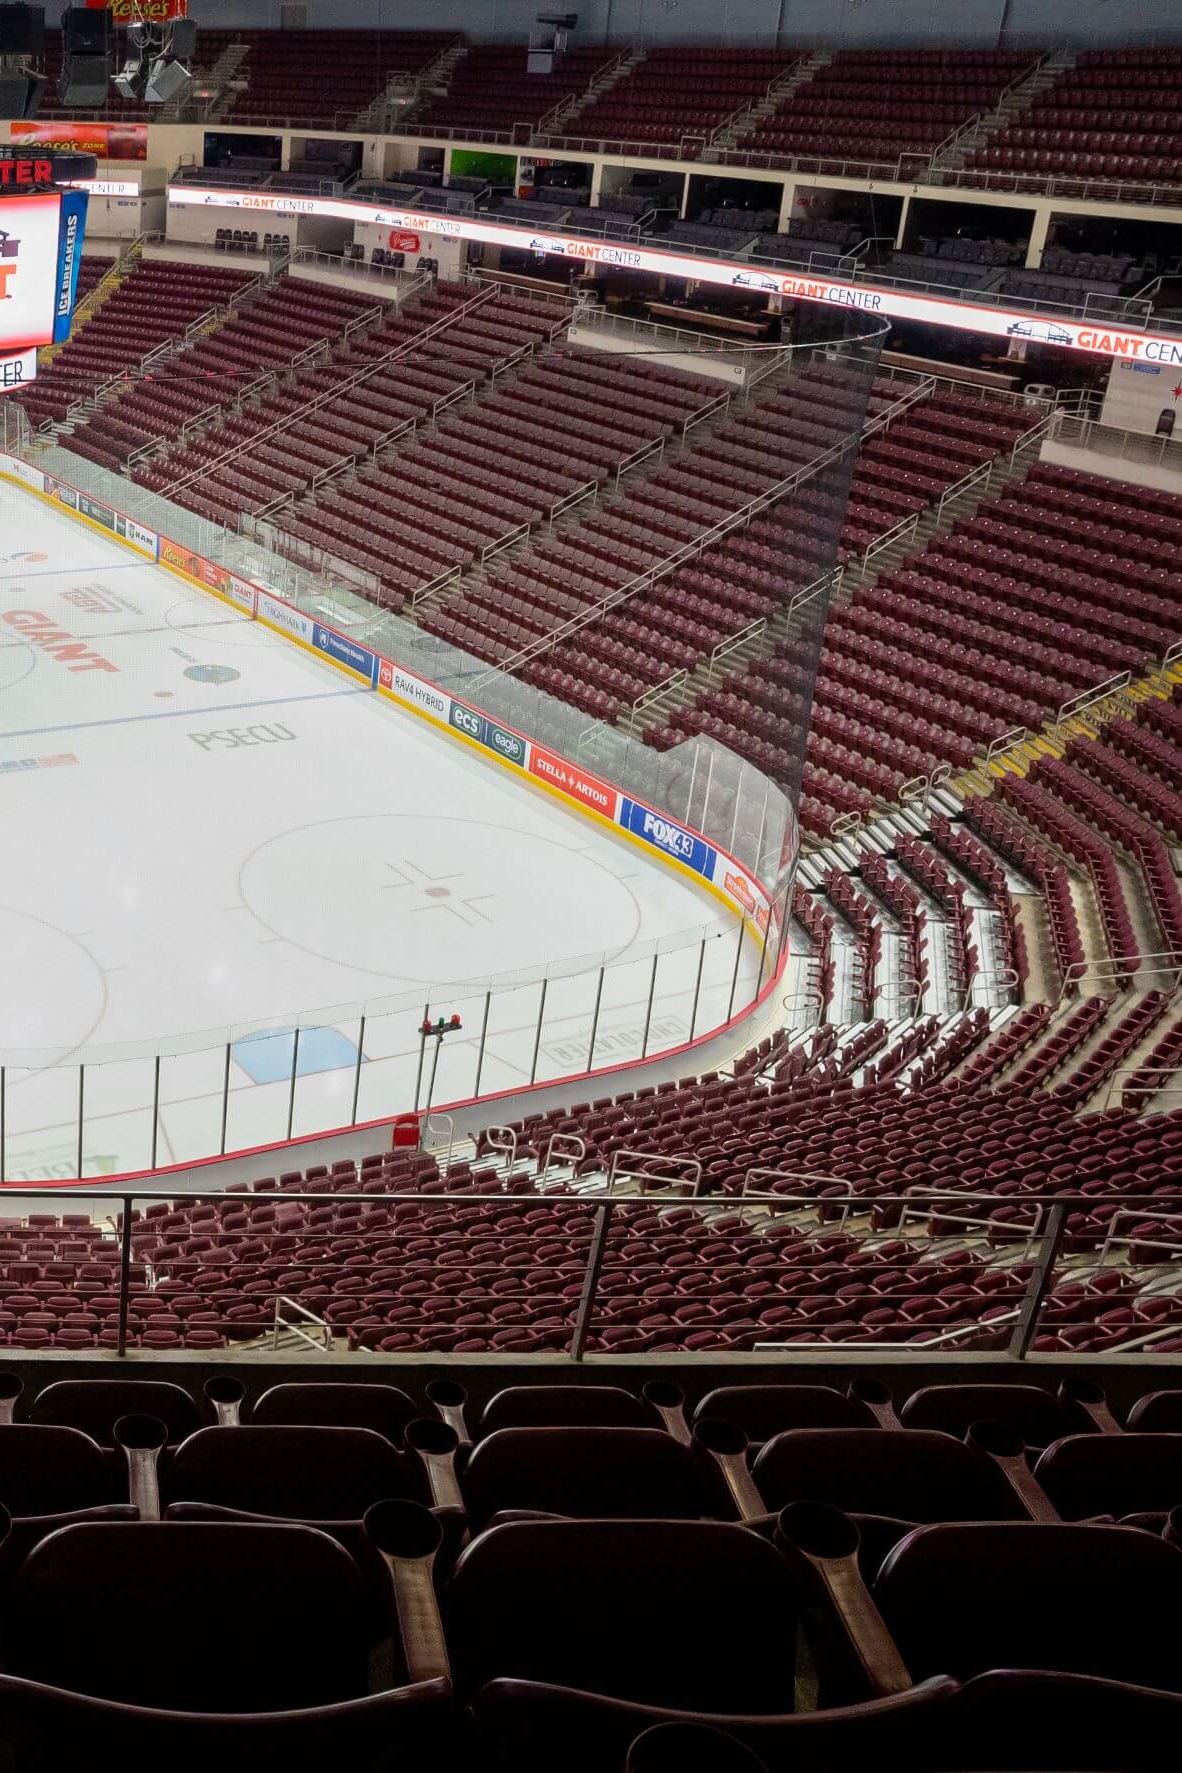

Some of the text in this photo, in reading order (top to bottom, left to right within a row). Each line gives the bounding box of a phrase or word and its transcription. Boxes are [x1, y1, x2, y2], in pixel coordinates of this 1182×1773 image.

[242, 197, 314, 212] GIANT CENTER
[403, 216, 430, 230] GIANT
[567, 242, 641, 266] GIANT CENTER
[782, 279, 882, 310] GIANT CENTER
[1077, 331, 1144, 357] GIANT
[1, 609, 121, 673] GIANT
[395, 674, 445, 713] RAV4 HYBRID
[454, 707, 479, 734] ecs
[187, 721, 298, 751] PSECU
[494, 731, 519, 755] eagle
[536, 757, 609, 807] STELLA ARTOIS
